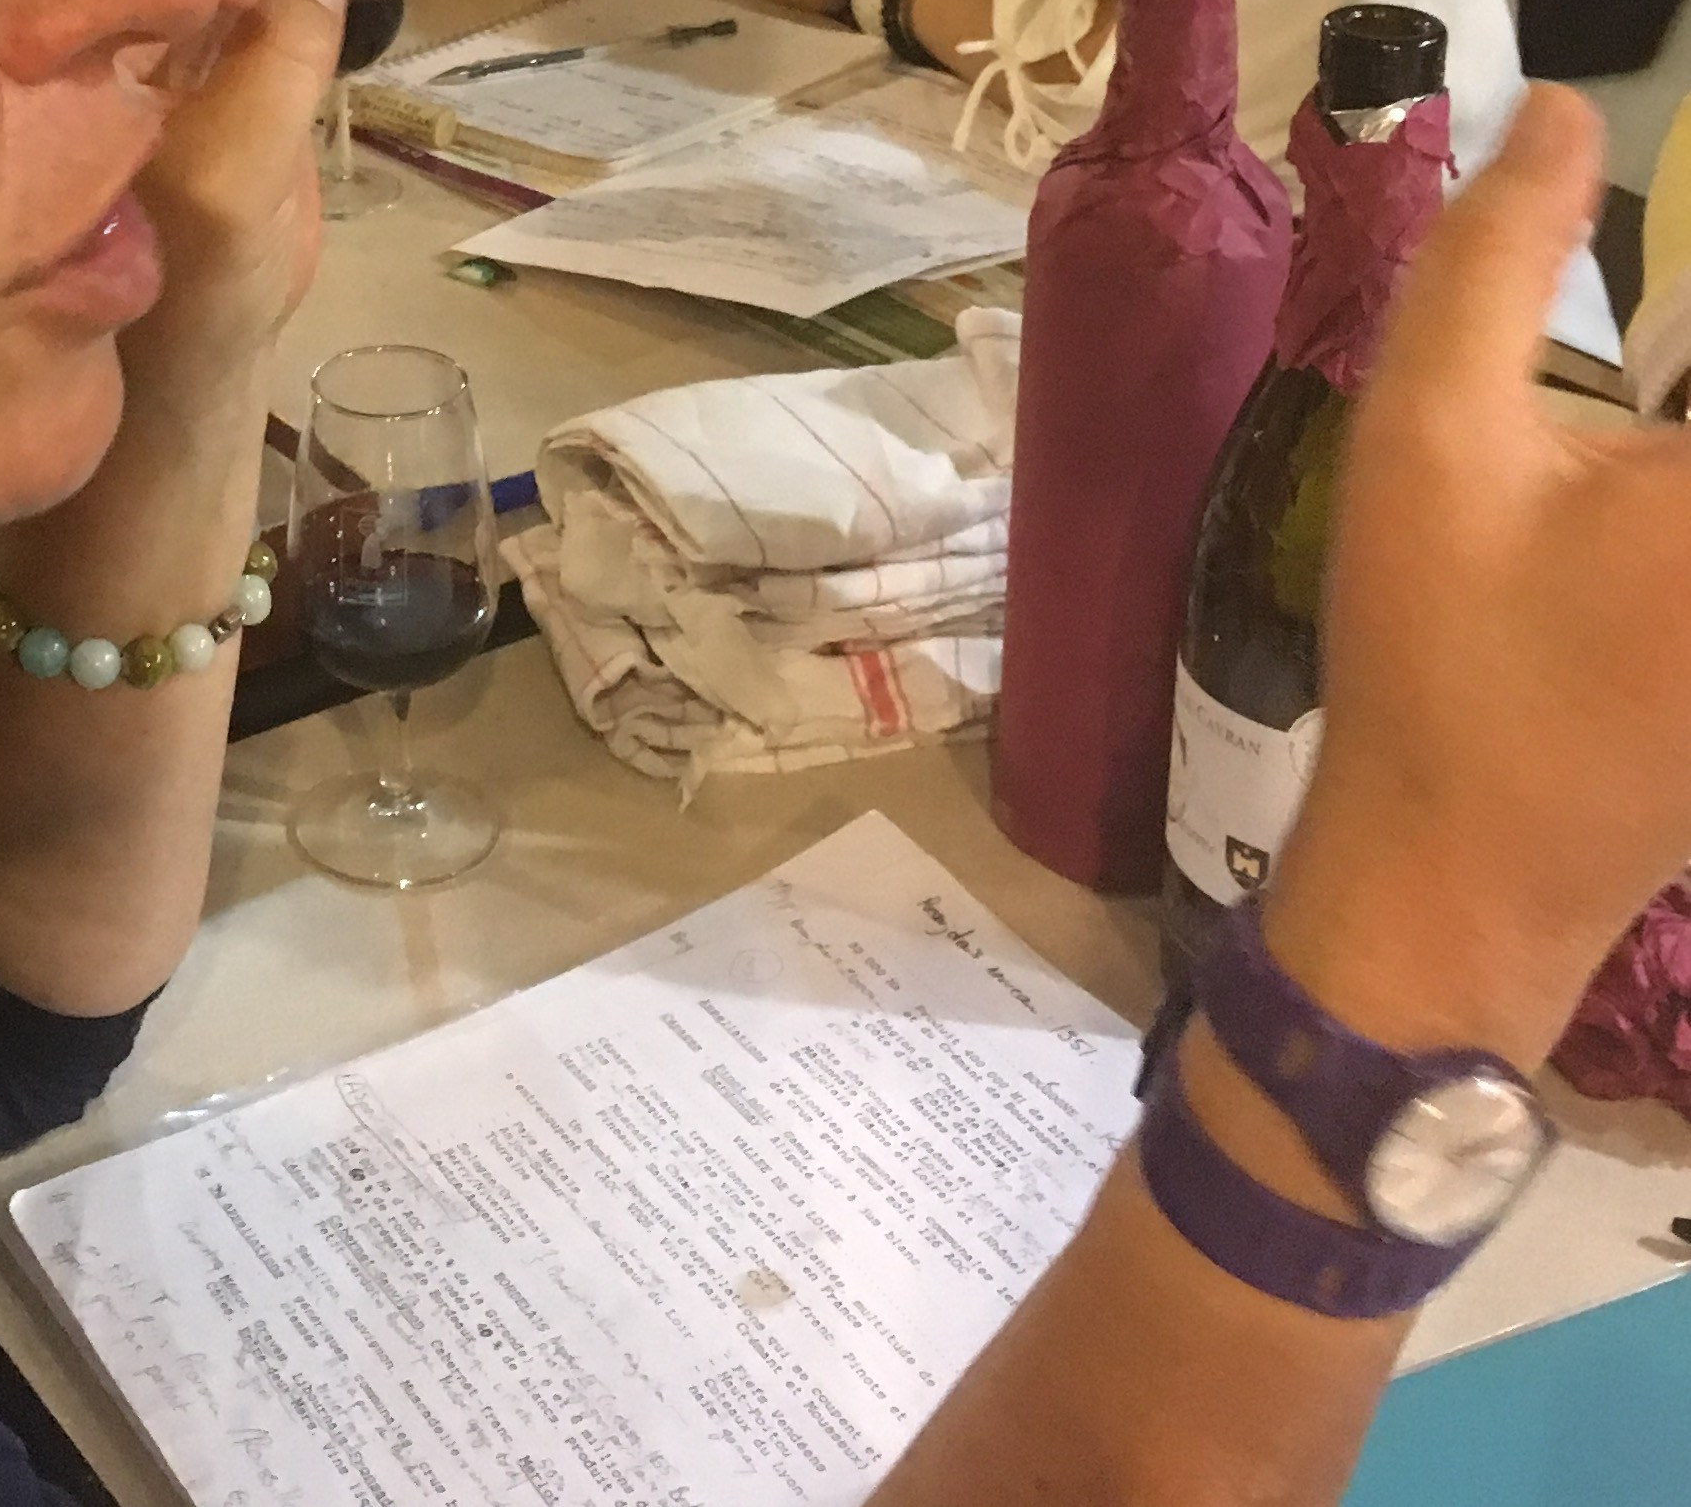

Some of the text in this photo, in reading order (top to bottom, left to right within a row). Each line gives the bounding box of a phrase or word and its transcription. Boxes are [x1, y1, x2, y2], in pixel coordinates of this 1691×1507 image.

[901, 1009, 920, 1023] et
[918, 1025, 938, 1040] du
[935, 1041, 986, 1083] Crémant
[983, 1084, 1004, 1100] de
[912, 1004, 963, 1045] Produit
[1026, 1106, 1048, 1122] de
[916, 1055, 936, 1070] de
[767, 1081, 786, 1096] de
[950, 1120, 971, 1135] de
[962, 1114, 983, 1130] de
[899, 1139, 918, 1153] et
[892, 1149, 912, 1164] et
[954, 1209, 975, 1225] et
[955, 1174, 974, 1188] et
[769, 1175, 790, 1191] DE
[787, 1192, 807, 1208] LA
[411, 1269, 432, 1287] de
[451, 1269, 472, 1287] de
[799, 1265, 820, 1282] en
[370, 1195, 390, 1212] de
[500, 1353, 521, 1372] de
[645, 1289, 666, 1306] du
[765, 1210, 784, 1226] et
[916, 1368, 940, 1388] de
[679, 1261, 700, 1278] de
[783, 1378, 804, 1396] et
[887, 1403, 910, 1422] et
[750, 1436, 774, 1457] du
[862, 1444, 885, 1463] et
